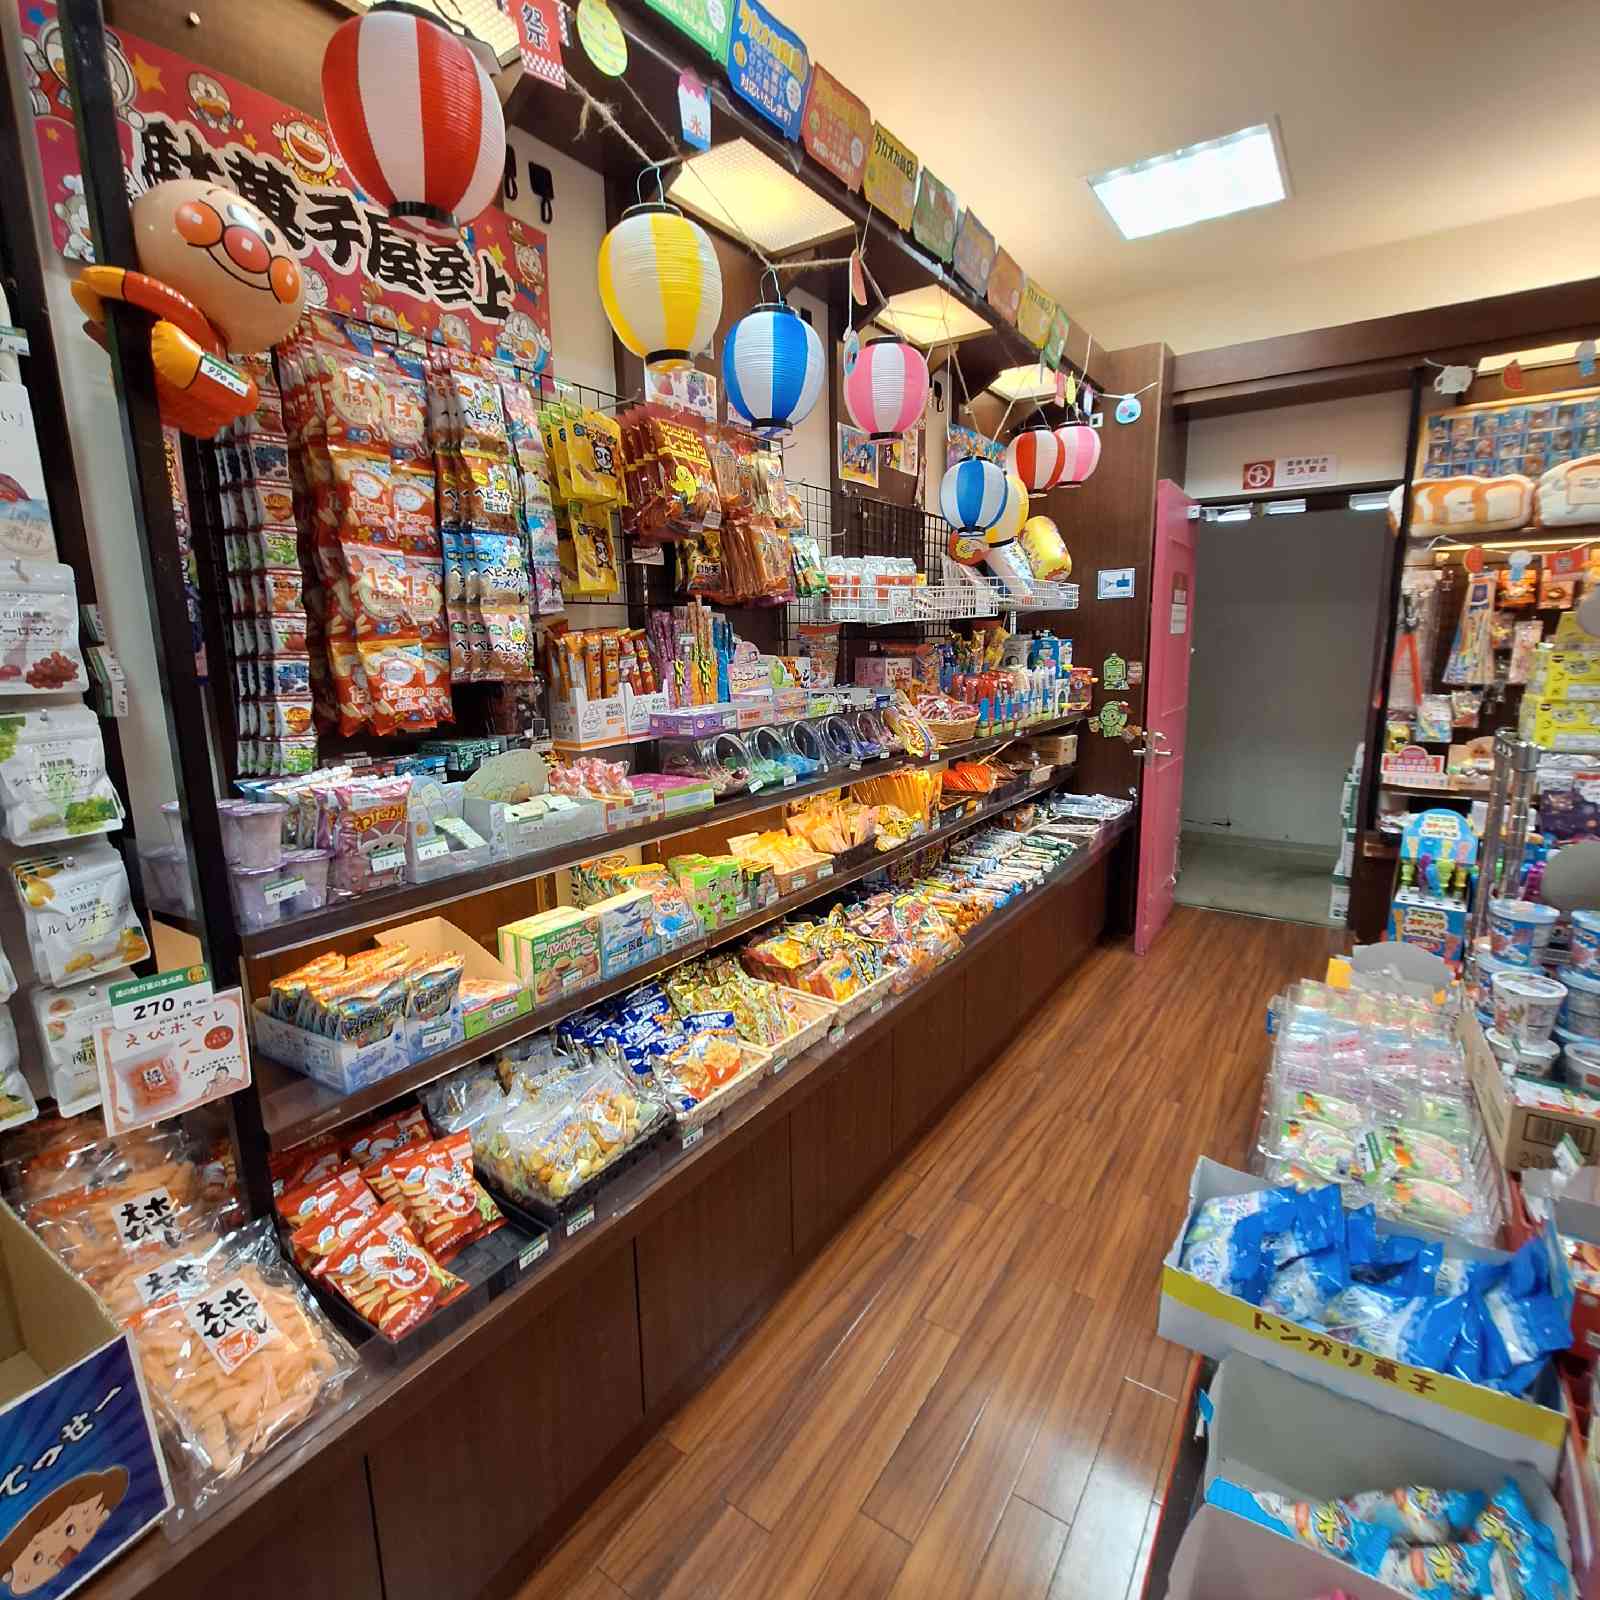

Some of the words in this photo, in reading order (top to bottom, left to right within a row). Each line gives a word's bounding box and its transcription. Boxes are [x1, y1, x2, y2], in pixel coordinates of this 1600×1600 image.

[522, 3, 550, 48] 祭
[141, 122, 512, 318] 駄菓子屋参上
[133, 997, 175, 1021] 270
[125, 1010, 225, 1050] えびホマレ
[120, 1202, 151, 1242] えび
[196, 1301, 236, 1339] えび
[1253, 1310, 1437, 1395] トンガリ菓子
